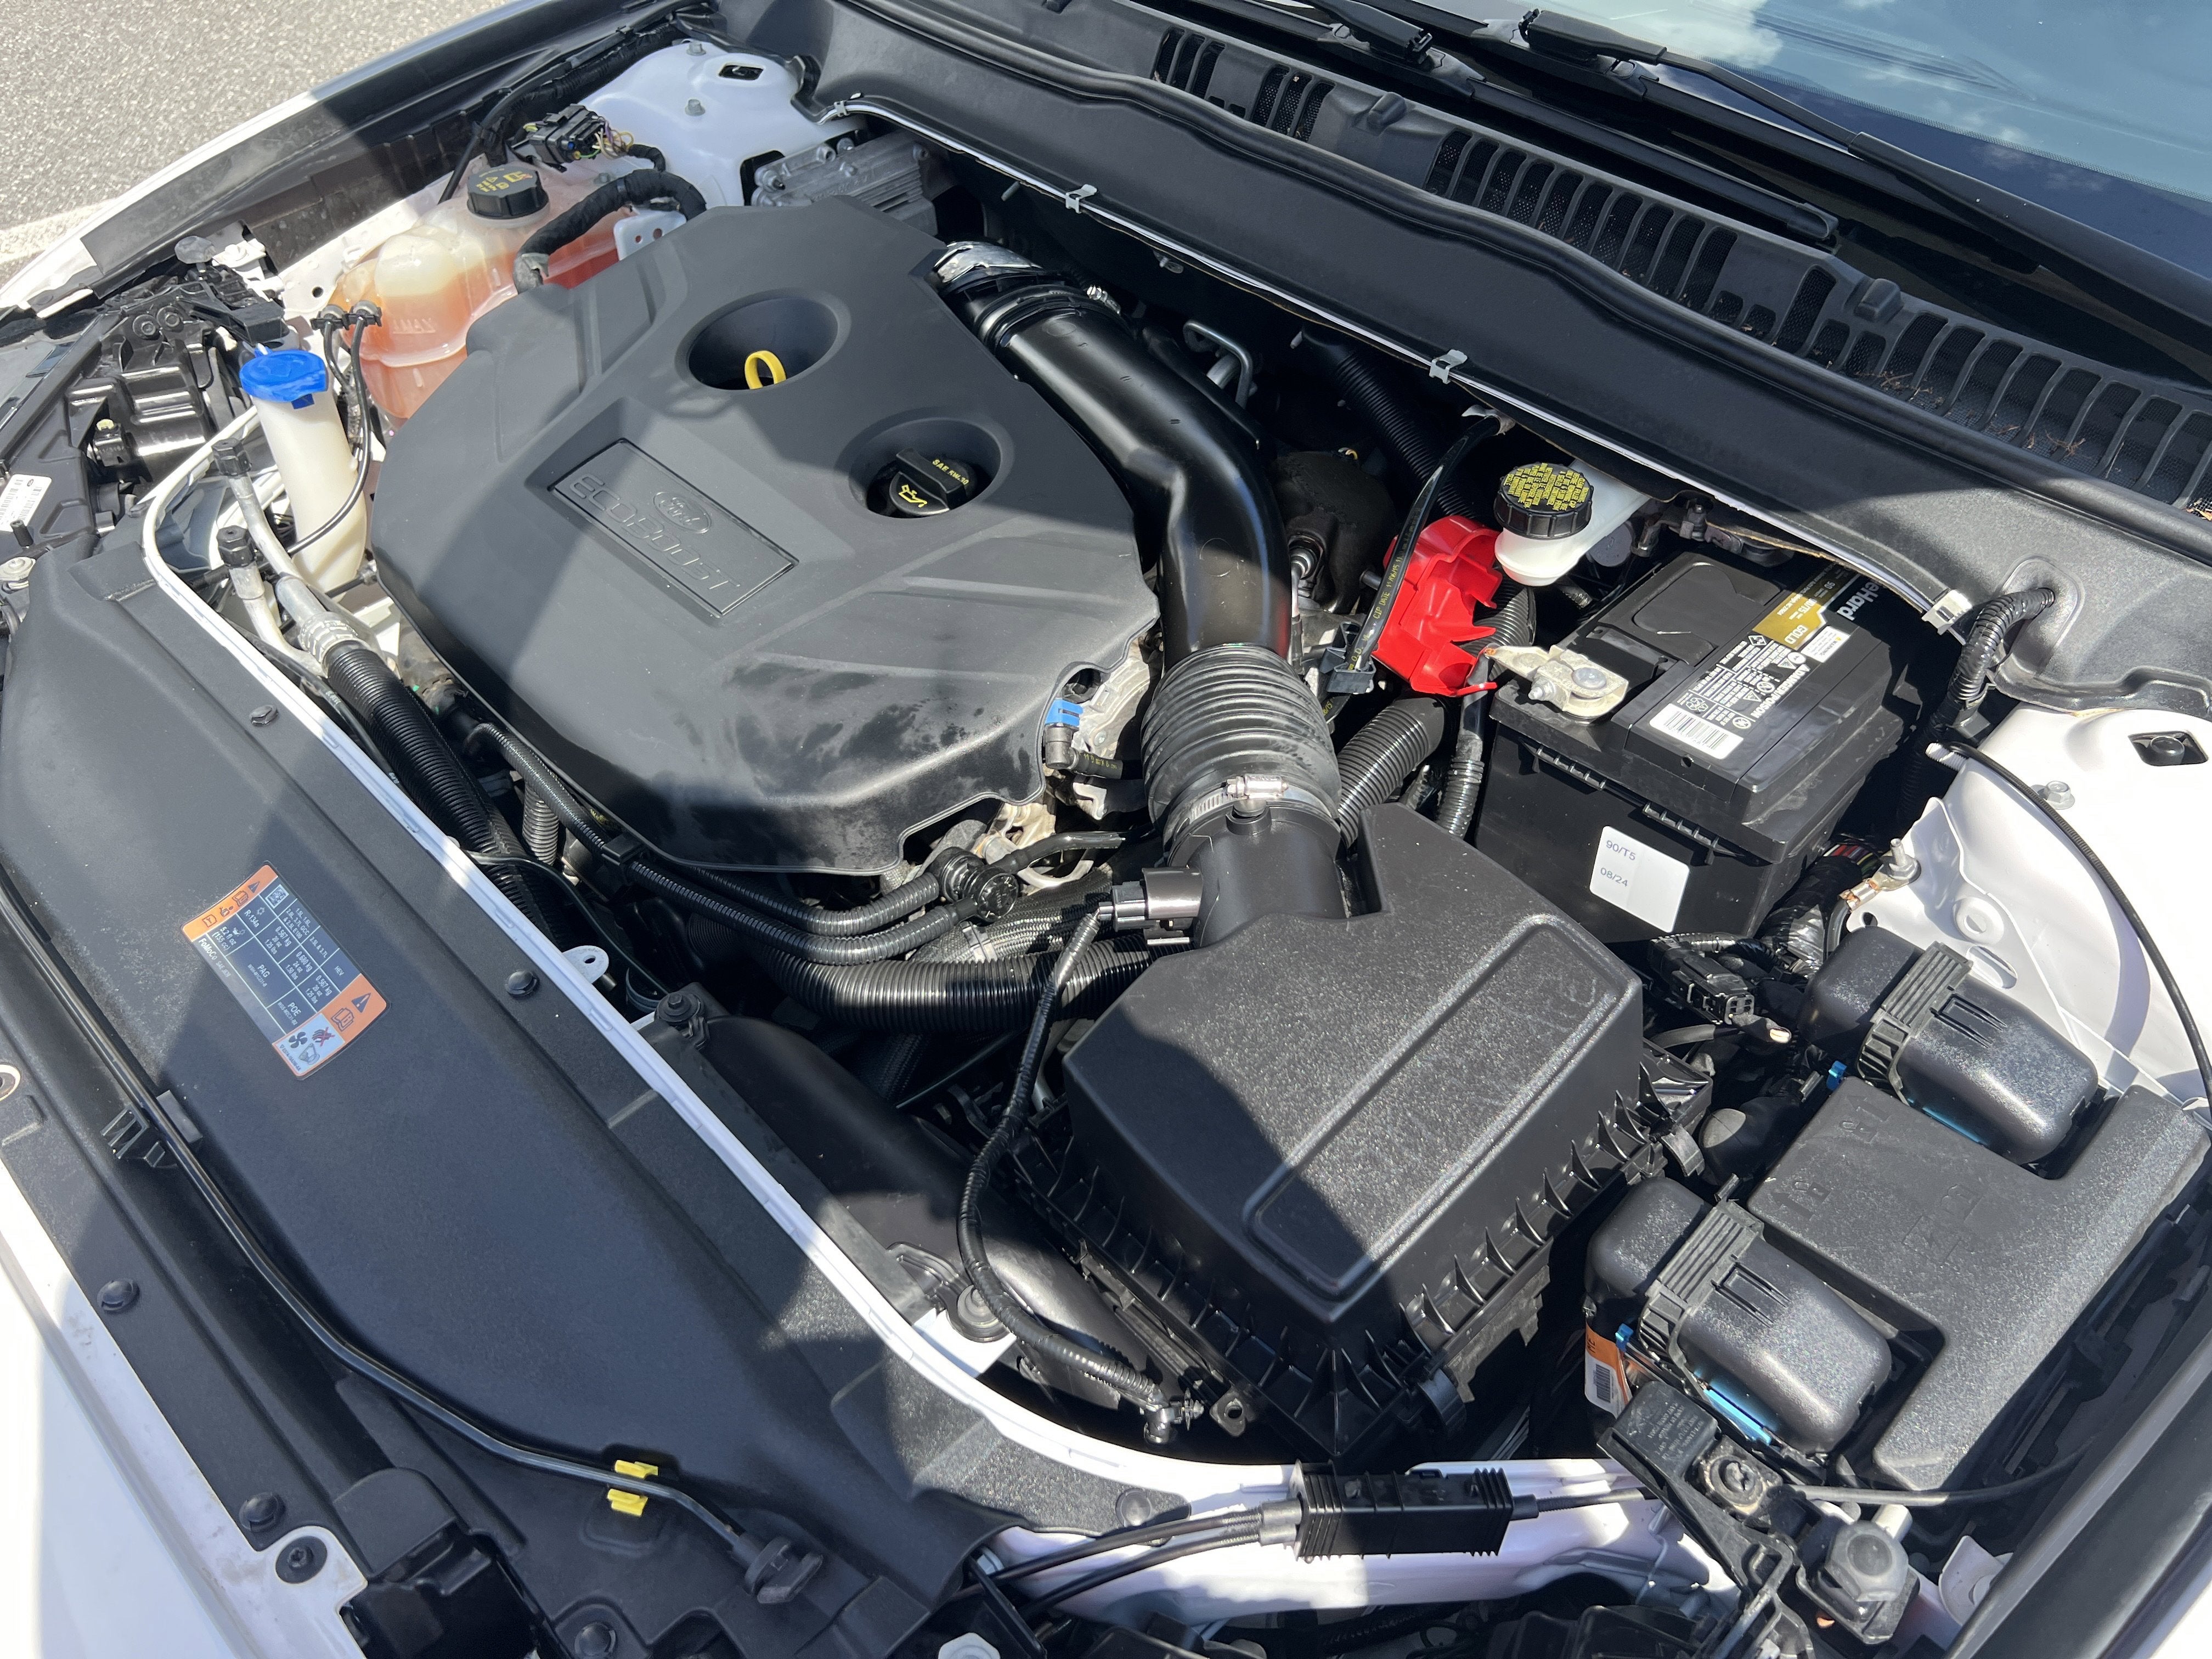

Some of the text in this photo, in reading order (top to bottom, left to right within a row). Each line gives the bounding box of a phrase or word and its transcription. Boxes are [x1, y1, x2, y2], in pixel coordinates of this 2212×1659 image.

[932, 459, 950, 472] SAE
[1378, 590, 1391, 607] DATE
[1836, 582, 1882, 622] eHard
[1782, 624, 1809, 645] GOLD
[1749, 668, 1805, 719] DANGER/POISON
[1606, 840, 1637, 861] 90/T5
[1600, 867, 1628, 887] 08/24
[243, 909, 261, 928] R-134a
[211, 930, 225, 944] (155
[219, 926, 230, 935] 5.2
[228, 938, 236, 946] oz
[274, 926, 294, 947] 0.567 kg
[298, 924, 310, 936] GCC
[198, 937, 219, 961] FoMoCo
[263, 938, 279, 955] 1.25 lbs
[257, 964, 270, 978] PAG
[295, 950, 314, 973] 0.680 kg
[333, 965, 345, 977] HEV
[284, 964, 300, 980] 1.50 lbs
[314, 974, 334, 996] 0.567 kg
[304, 988, 319, 1004] 1.25 lbs
[287, 1001, 301, 1017] POE
